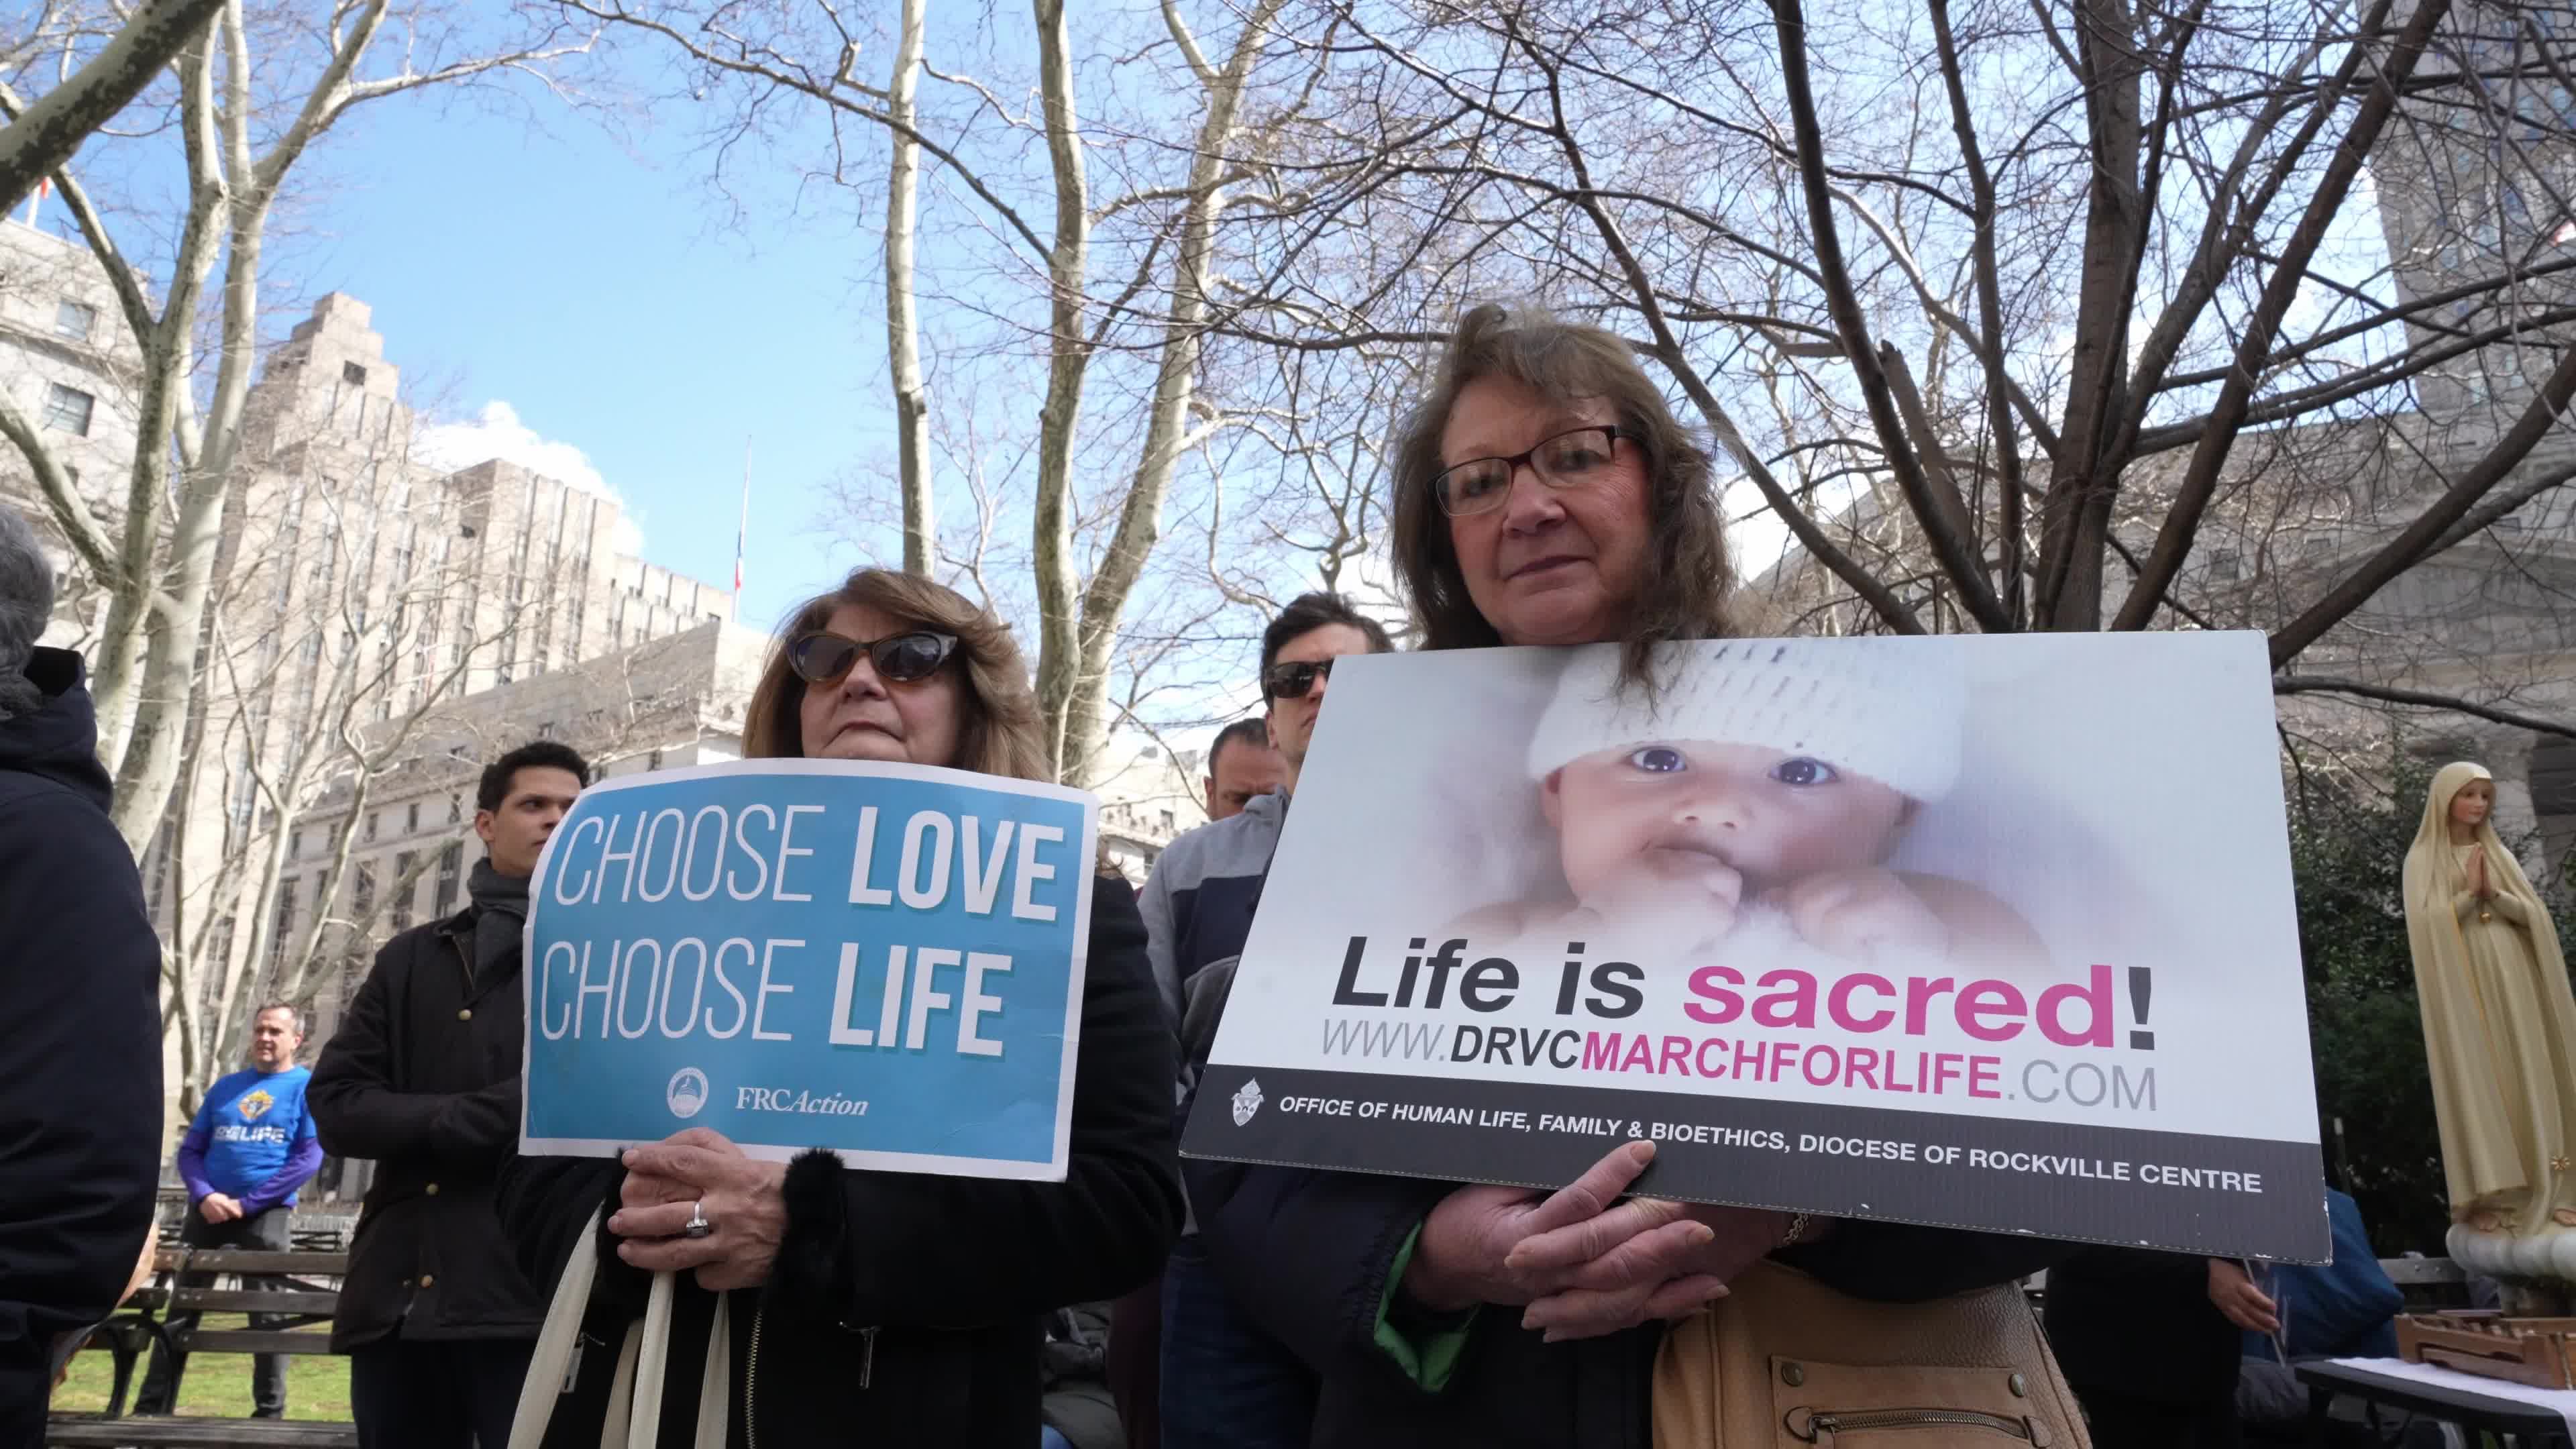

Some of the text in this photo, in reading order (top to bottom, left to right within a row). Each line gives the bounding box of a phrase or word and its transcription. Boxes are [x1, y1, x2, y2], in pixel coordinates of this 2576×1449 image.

[554, 804, 1064, 922] CHOOSE LOVE
[541, 937, 1012, 1057] CHOOSE LIFE
[1332, 936, 2155, 1051] Life is sacred!
[735, 1087, 869, 1116] FRCAction
[1323, 1018, 2157, 1111] WWW.DRVCMARCHFORLIFE.COM
[1279, 1095, 2263, 1193] OFFICE OF HUMAN LIFE, FAMILY & BIOETHICS, DIOCESE OF ROCKVILLE CENTRE
